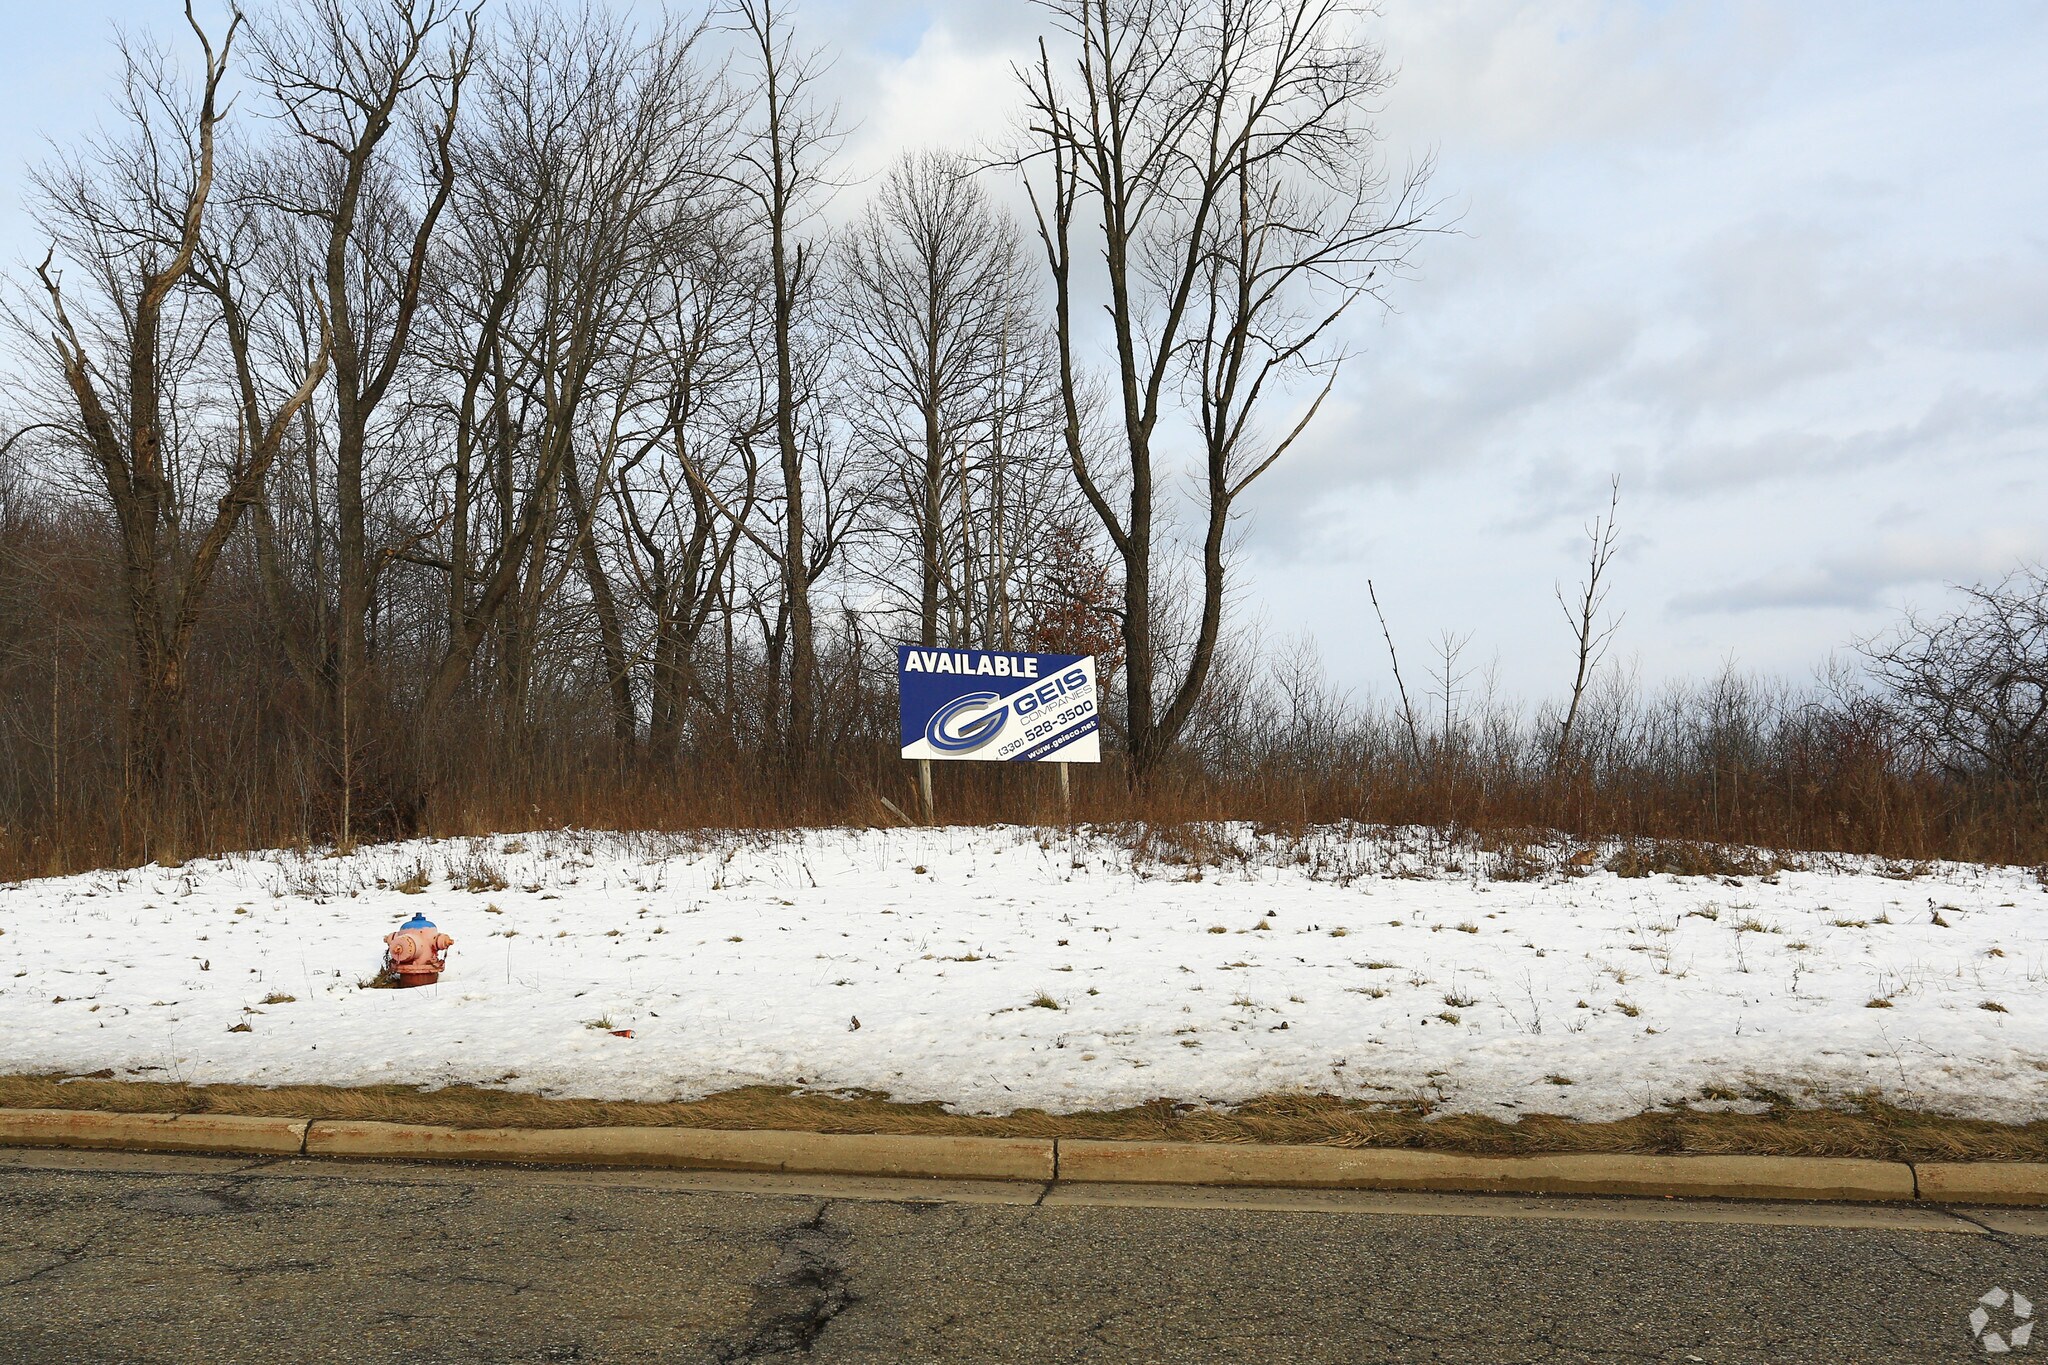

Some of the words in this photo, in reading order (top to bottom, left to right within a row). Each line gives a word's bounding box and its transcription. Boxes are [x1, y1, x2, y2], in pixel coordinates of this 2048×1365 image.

[905, 650, 1038, 678] AVAILABLE
[1013, 668, 1087, 716] GEIS
[1020, 684, 1093, 726] COMPANIES
[998, 738, 1025, 756] (330)
[1025, 700, 1093, 742] 528-3500
[1027, 720, 1096, 759] www.geisco.net
